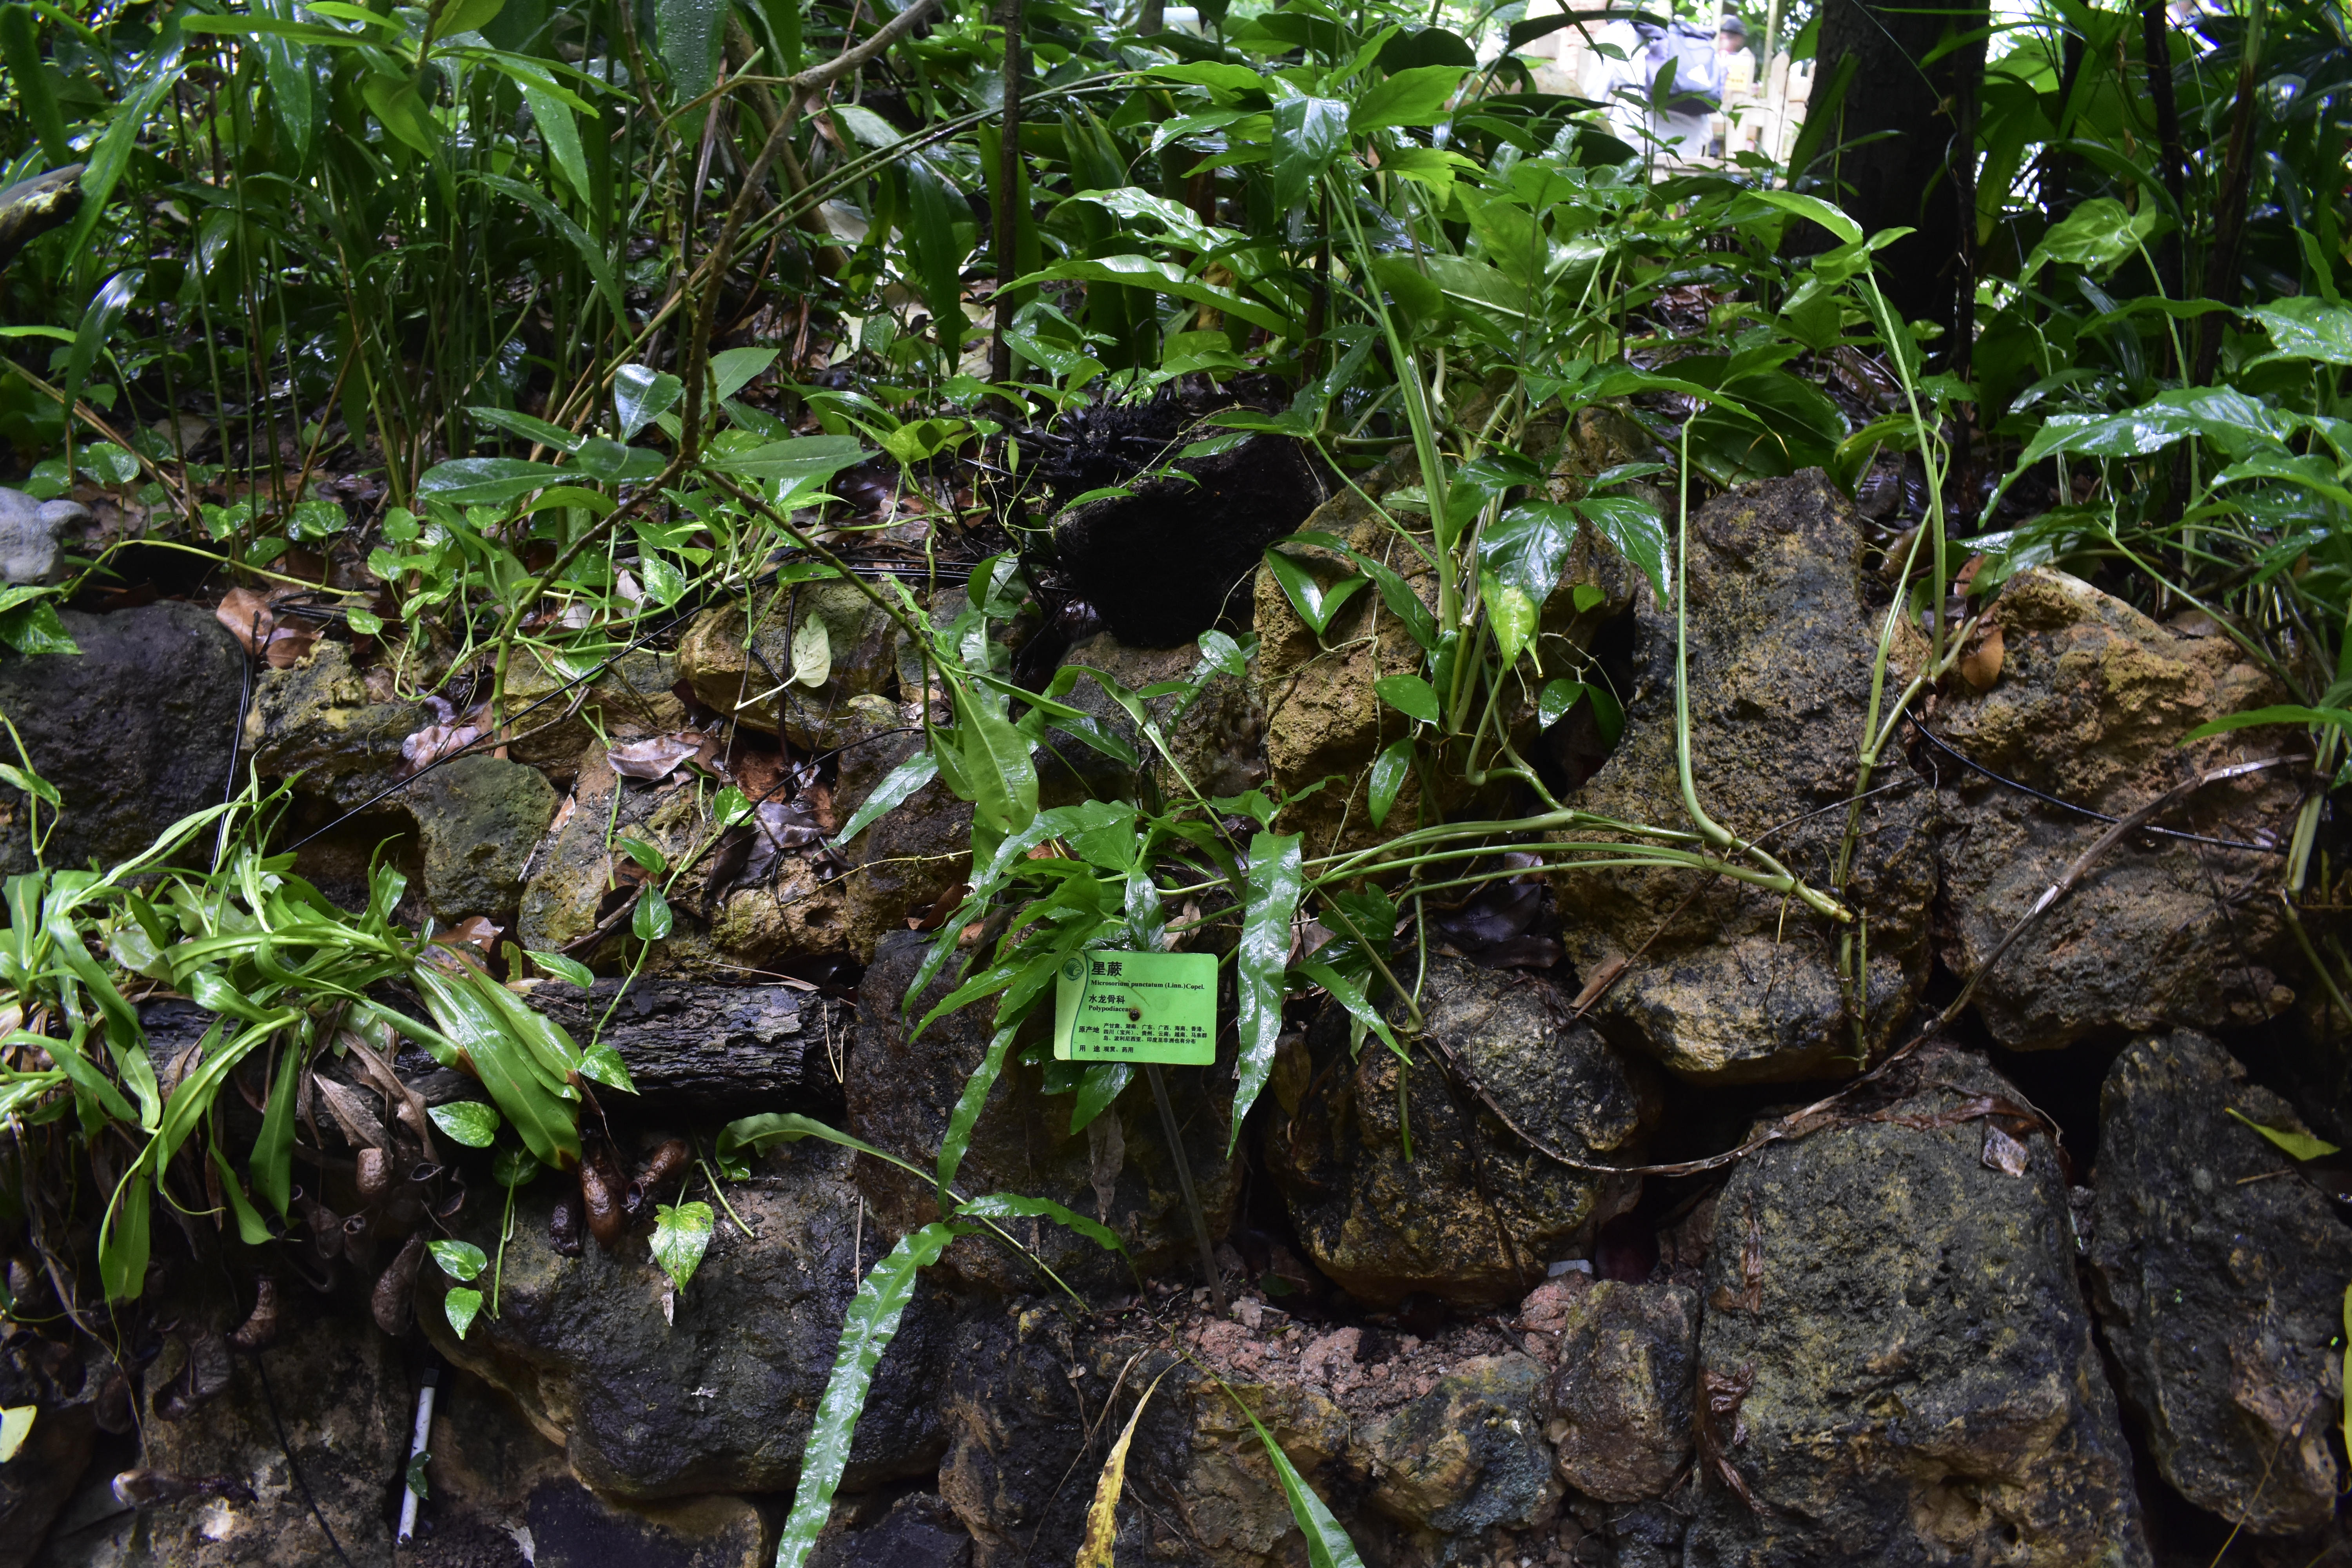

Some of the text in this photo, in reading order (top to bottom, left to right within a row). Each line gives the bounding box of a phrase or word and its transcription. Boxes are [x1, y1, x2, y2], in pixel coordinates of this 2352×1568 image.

[1091, 961, 1122, 976] 星蕨
[1089, 994, 1125, 1004] 水龙骨科
